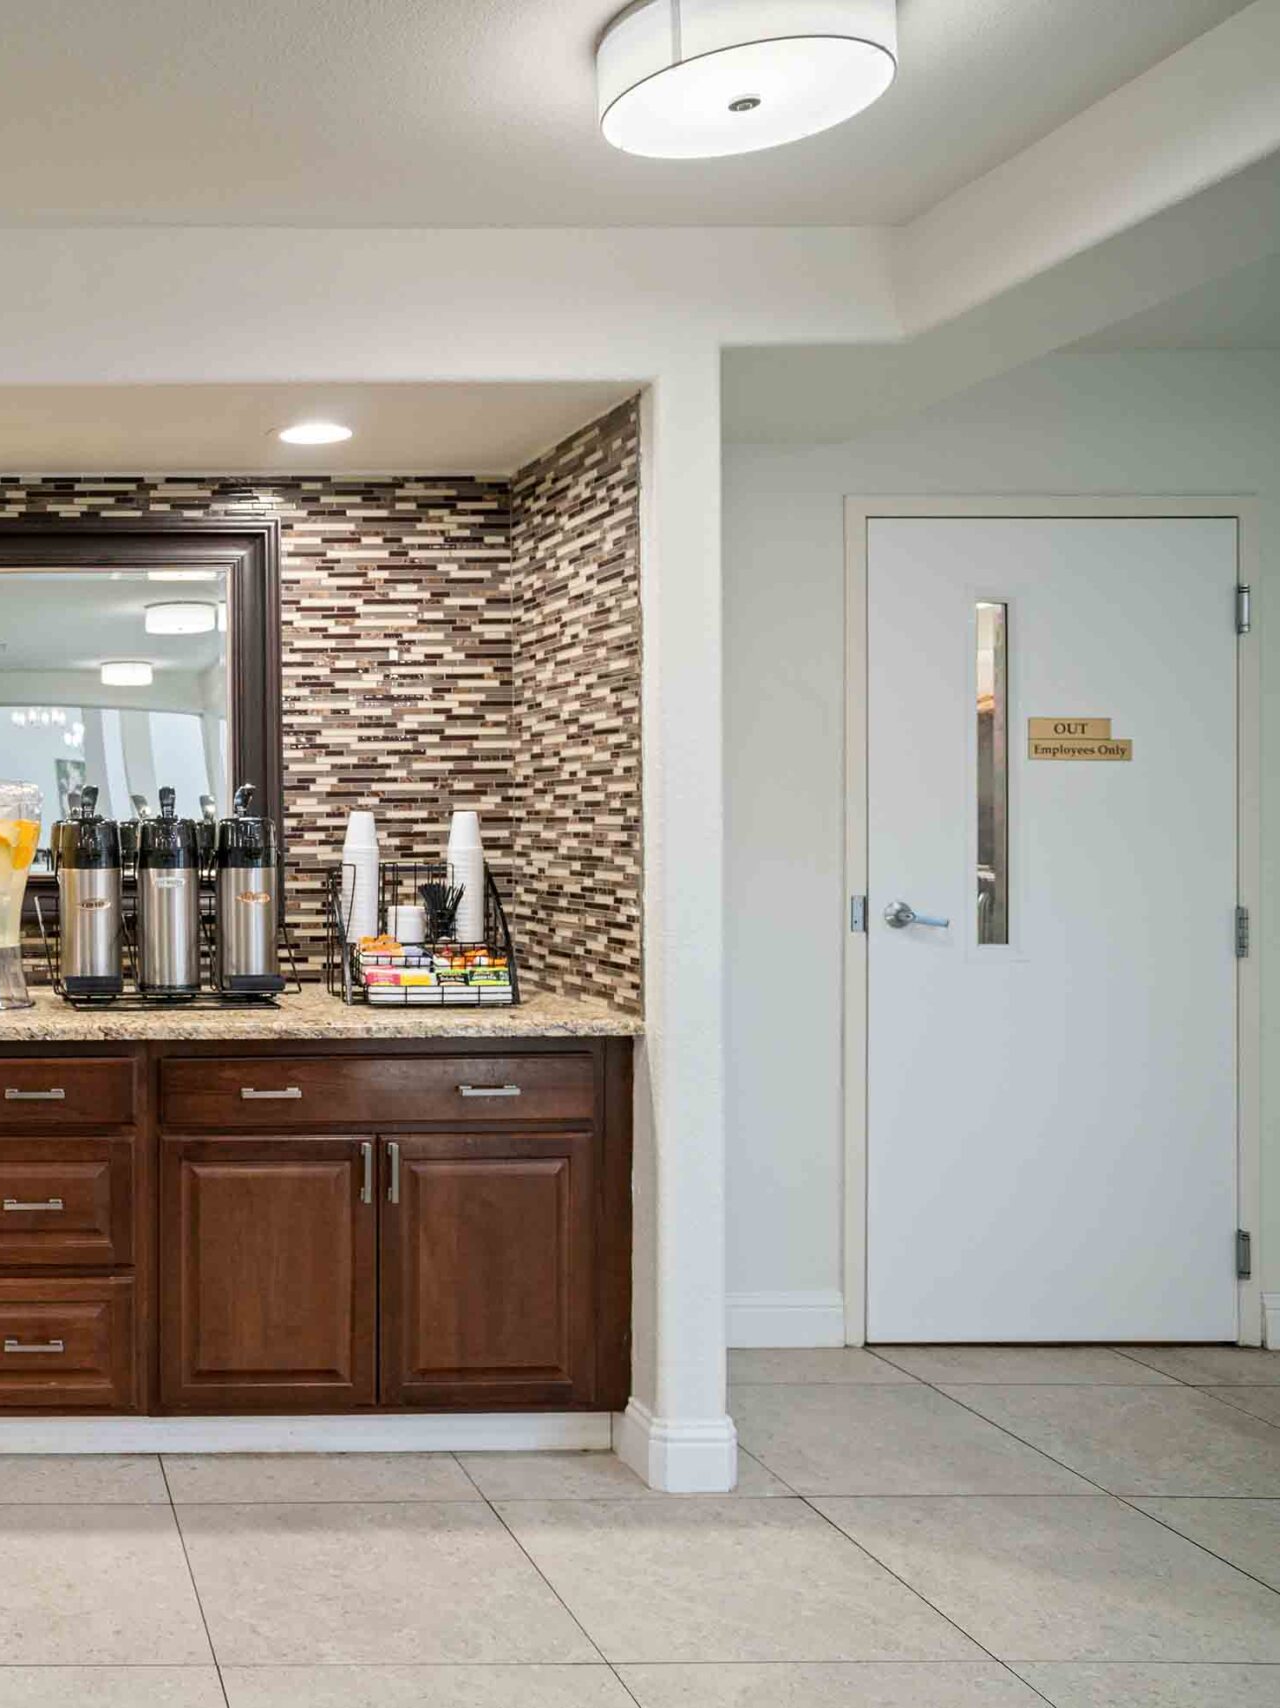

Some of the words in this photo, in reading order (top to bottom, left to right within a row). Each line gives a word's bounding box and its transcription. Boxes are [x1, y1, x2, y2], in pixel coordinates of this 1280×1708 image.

[1053, 722, 1088, 735] OUT
[1033, 744, 1096, 757] Employees
[1097, 745, 1127, 758] Only
